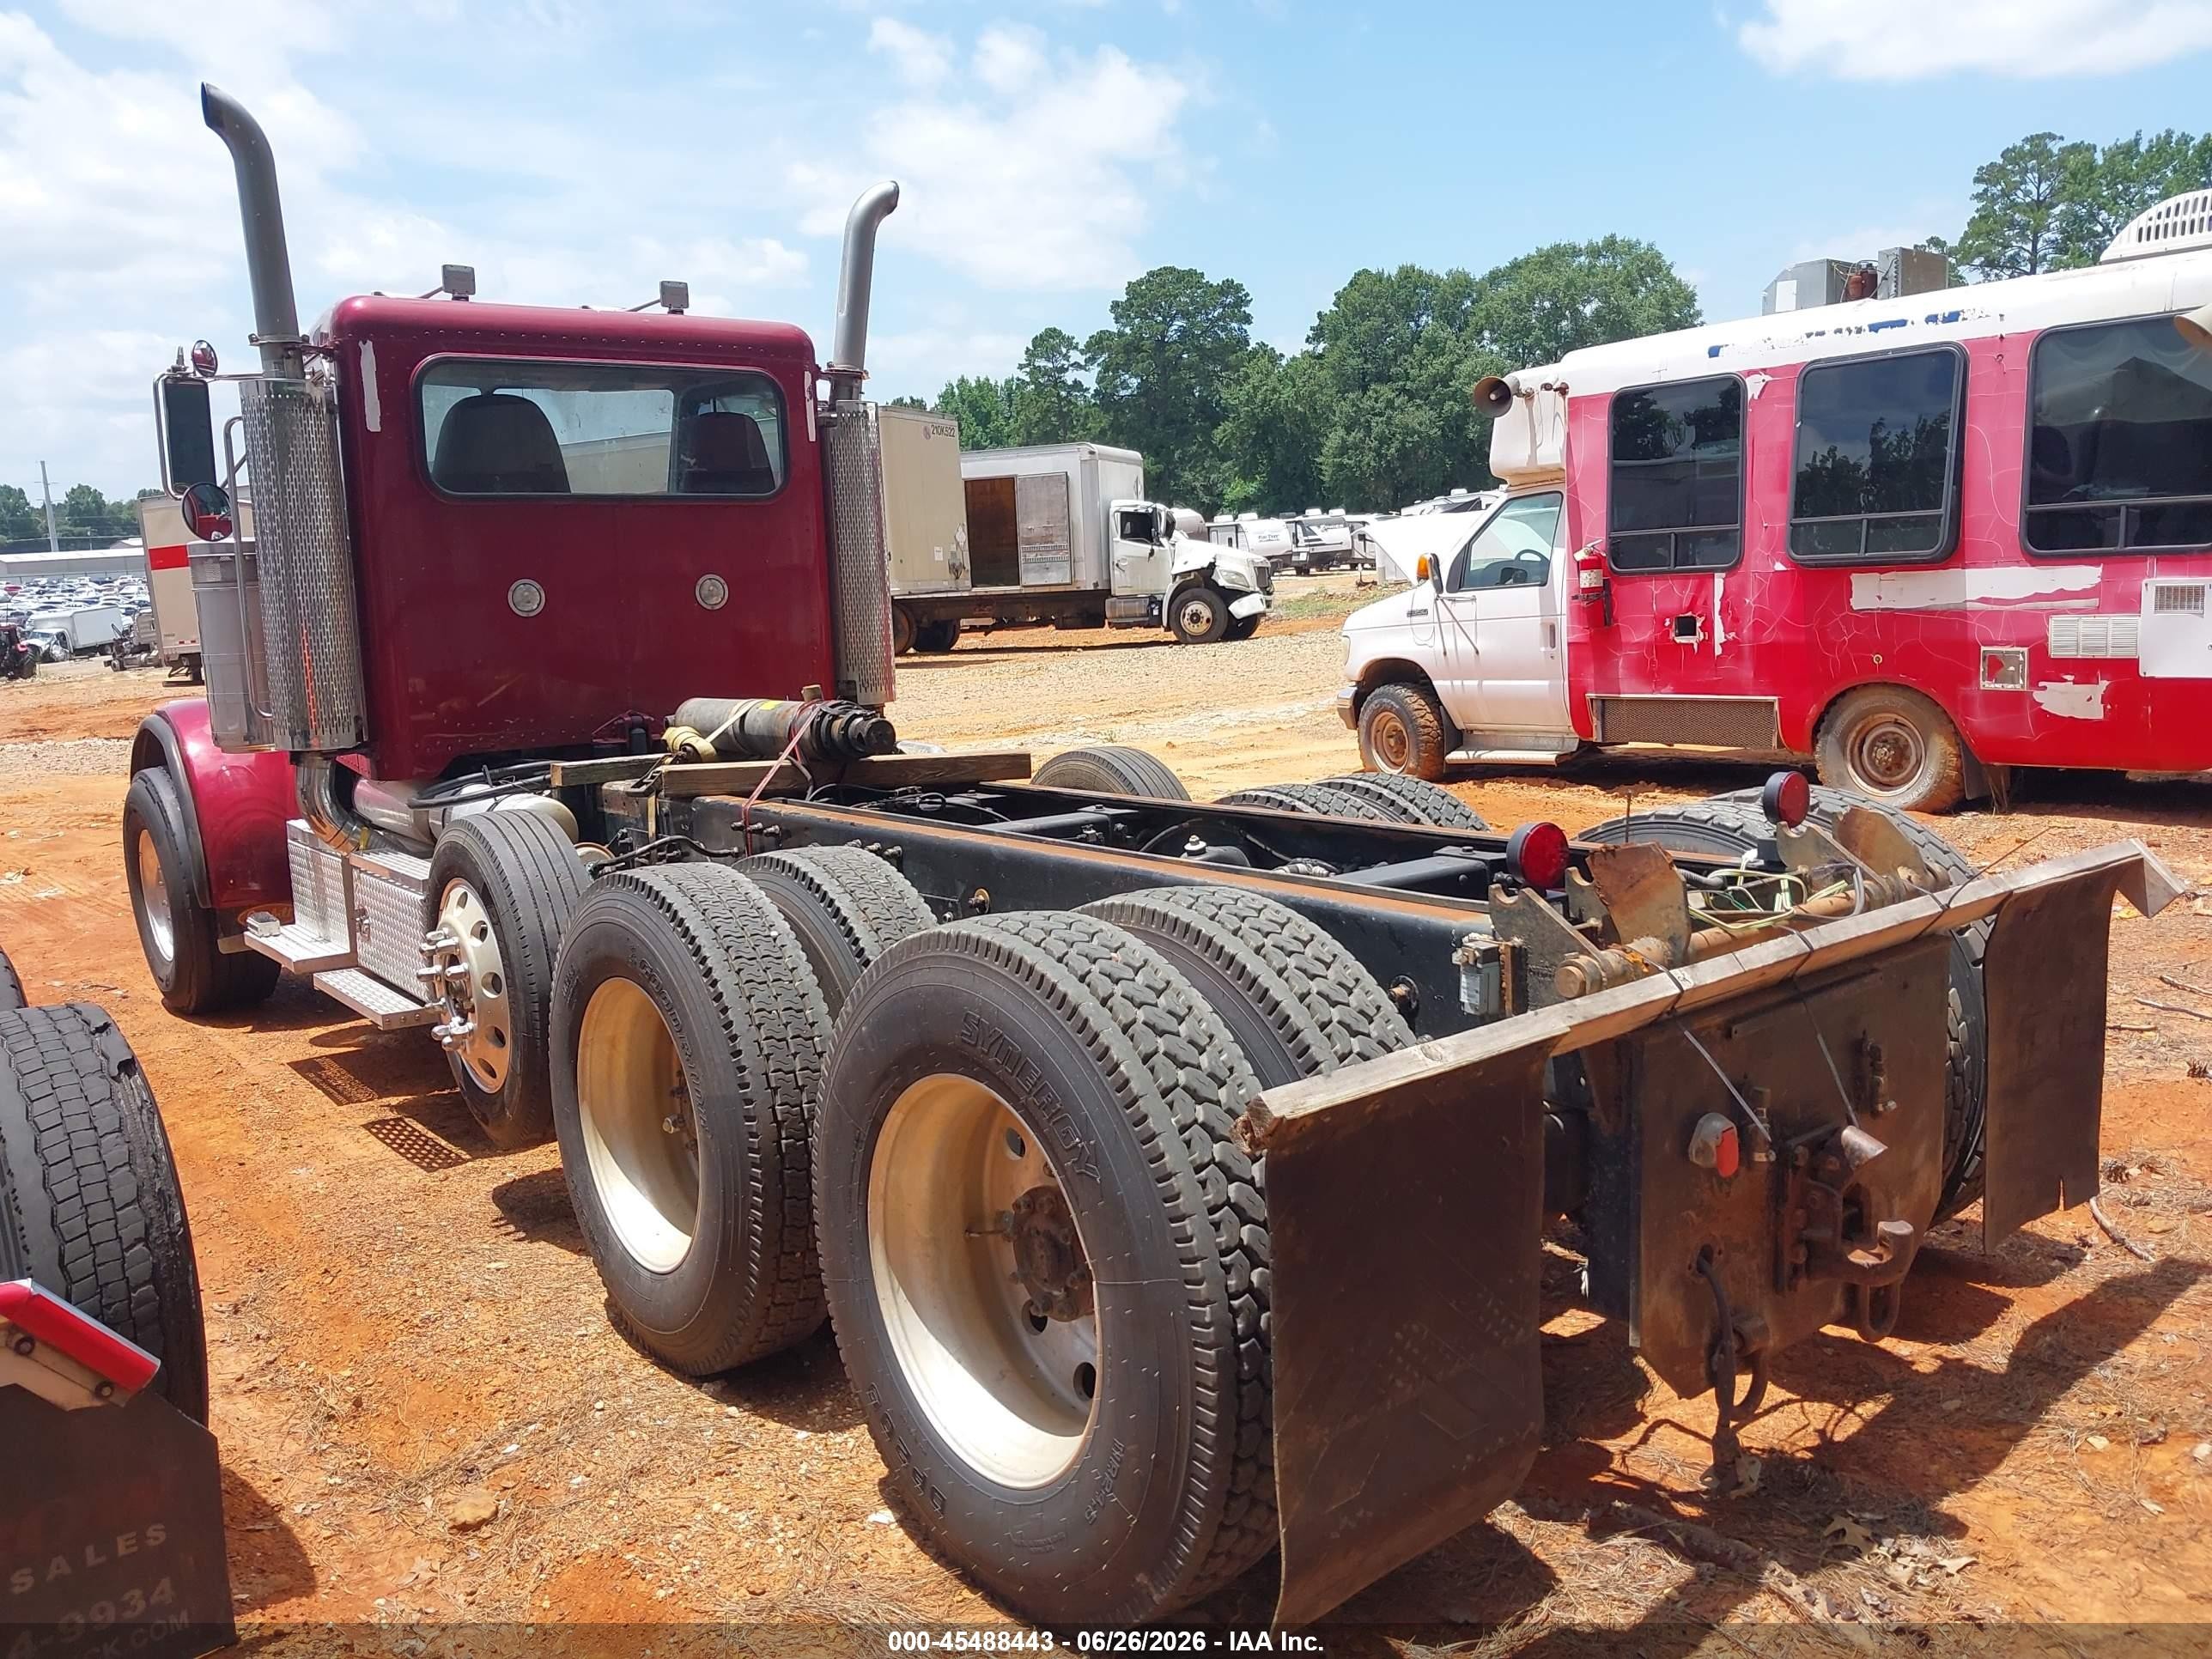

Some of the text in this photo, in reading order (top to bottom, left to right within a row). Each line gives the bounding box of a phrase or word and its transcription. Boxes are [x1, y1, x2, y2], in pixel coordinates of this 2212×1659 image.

[931, 424, 956, 438] 210K522
[960, 1009, 1101, 1182] SYNERGY
[9, 1522, 168, 1595] SALES
